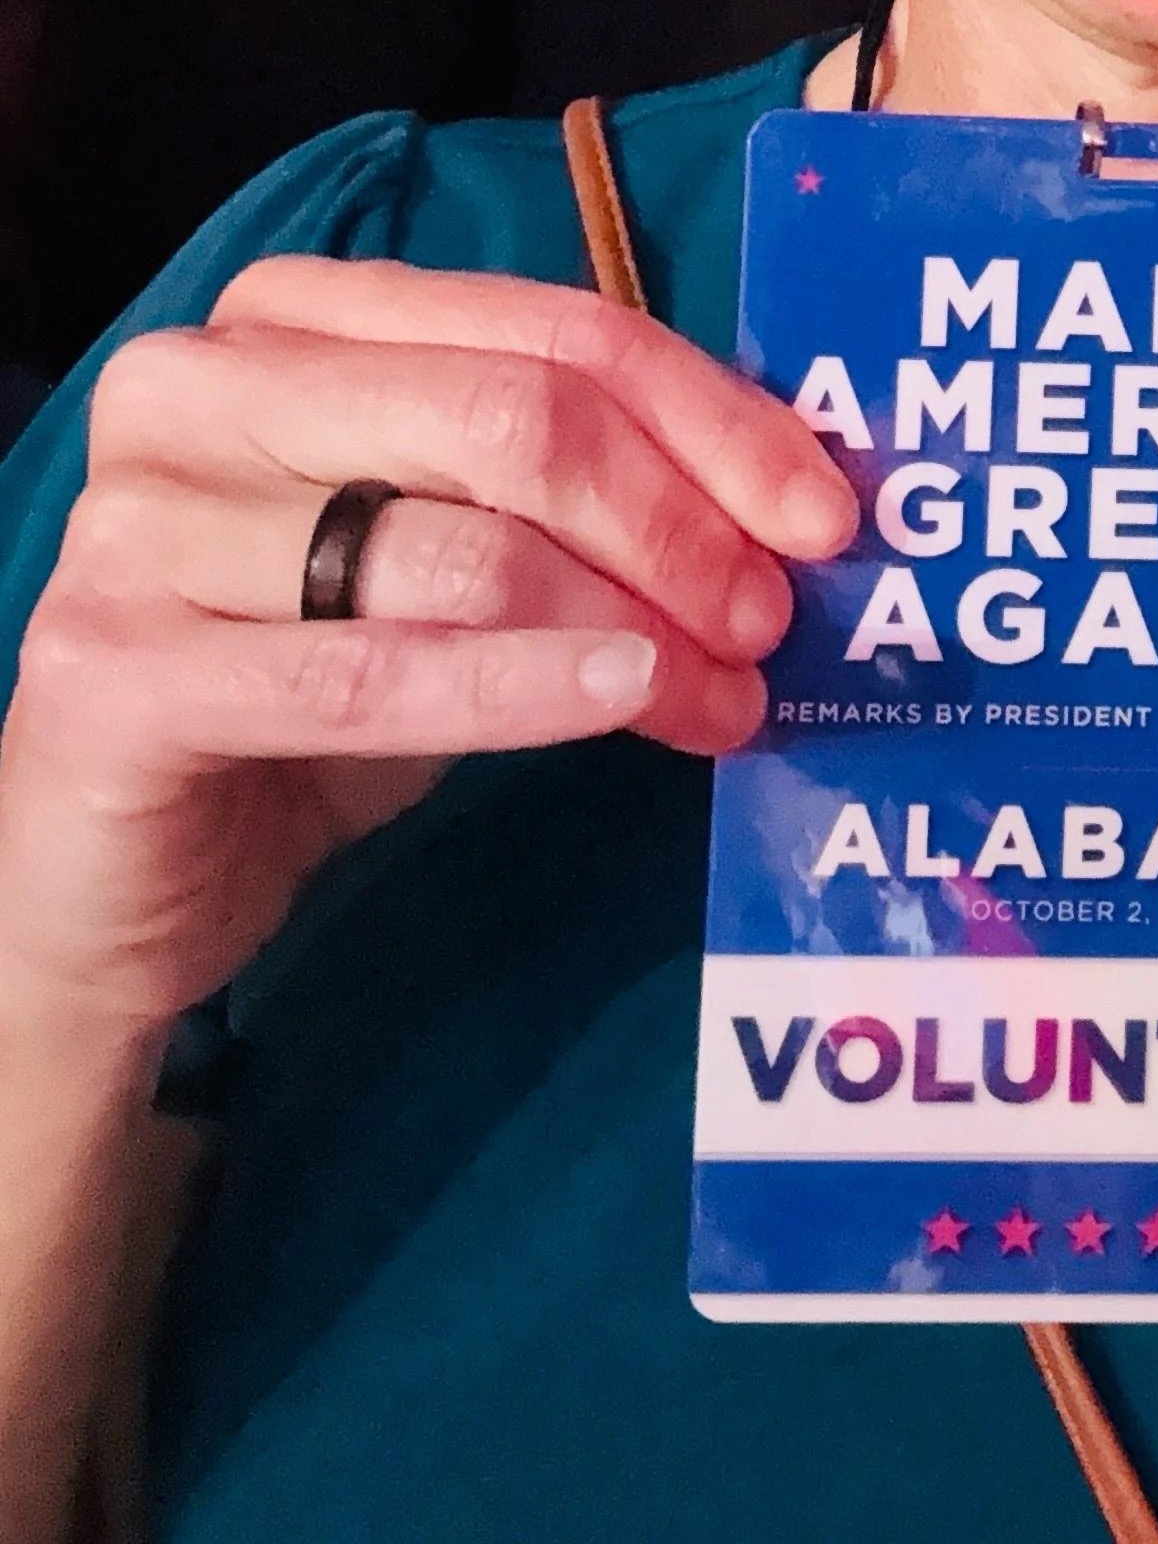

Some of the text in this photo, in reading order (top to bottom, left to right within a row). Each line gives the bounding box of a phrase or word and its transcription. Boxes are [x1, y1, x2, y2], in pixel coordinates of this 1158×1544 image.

[777, 701, 922, 724] REMARKS
[935, 703, 973, 725] BY
[985, 703, 1153, 728] PRESIDENT
[971, 899, 1115, 922] OCTOBER
[1127, 900, 1150, 925] 2,
